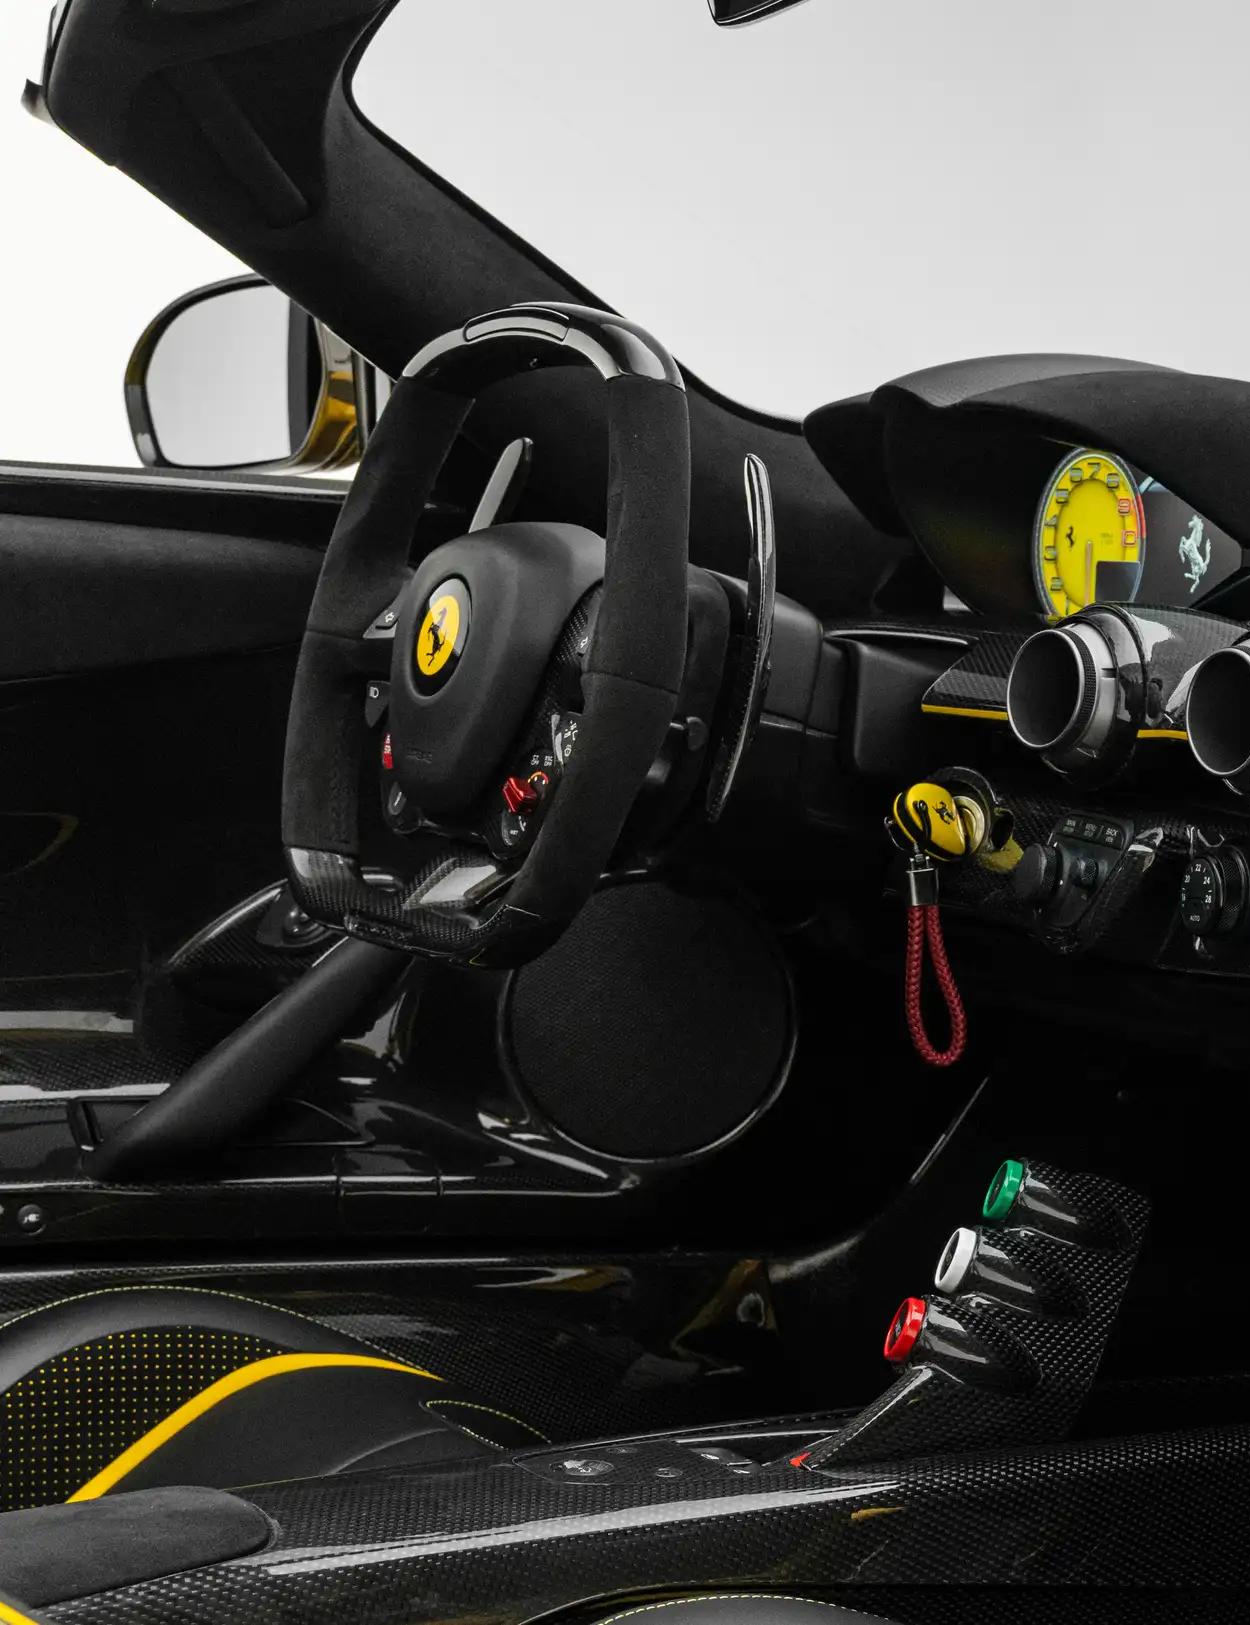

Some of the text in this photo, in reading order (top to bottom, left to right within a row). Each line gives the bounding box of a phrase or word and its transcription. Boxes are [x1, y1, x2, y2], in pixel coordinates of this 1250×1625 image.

[1088, 462, 1101, 479] 7
[1118, 498, 1131, 516] 9
[1195, 863, 1202, 872] 22
[1203, 876, 1211, 885] 24
